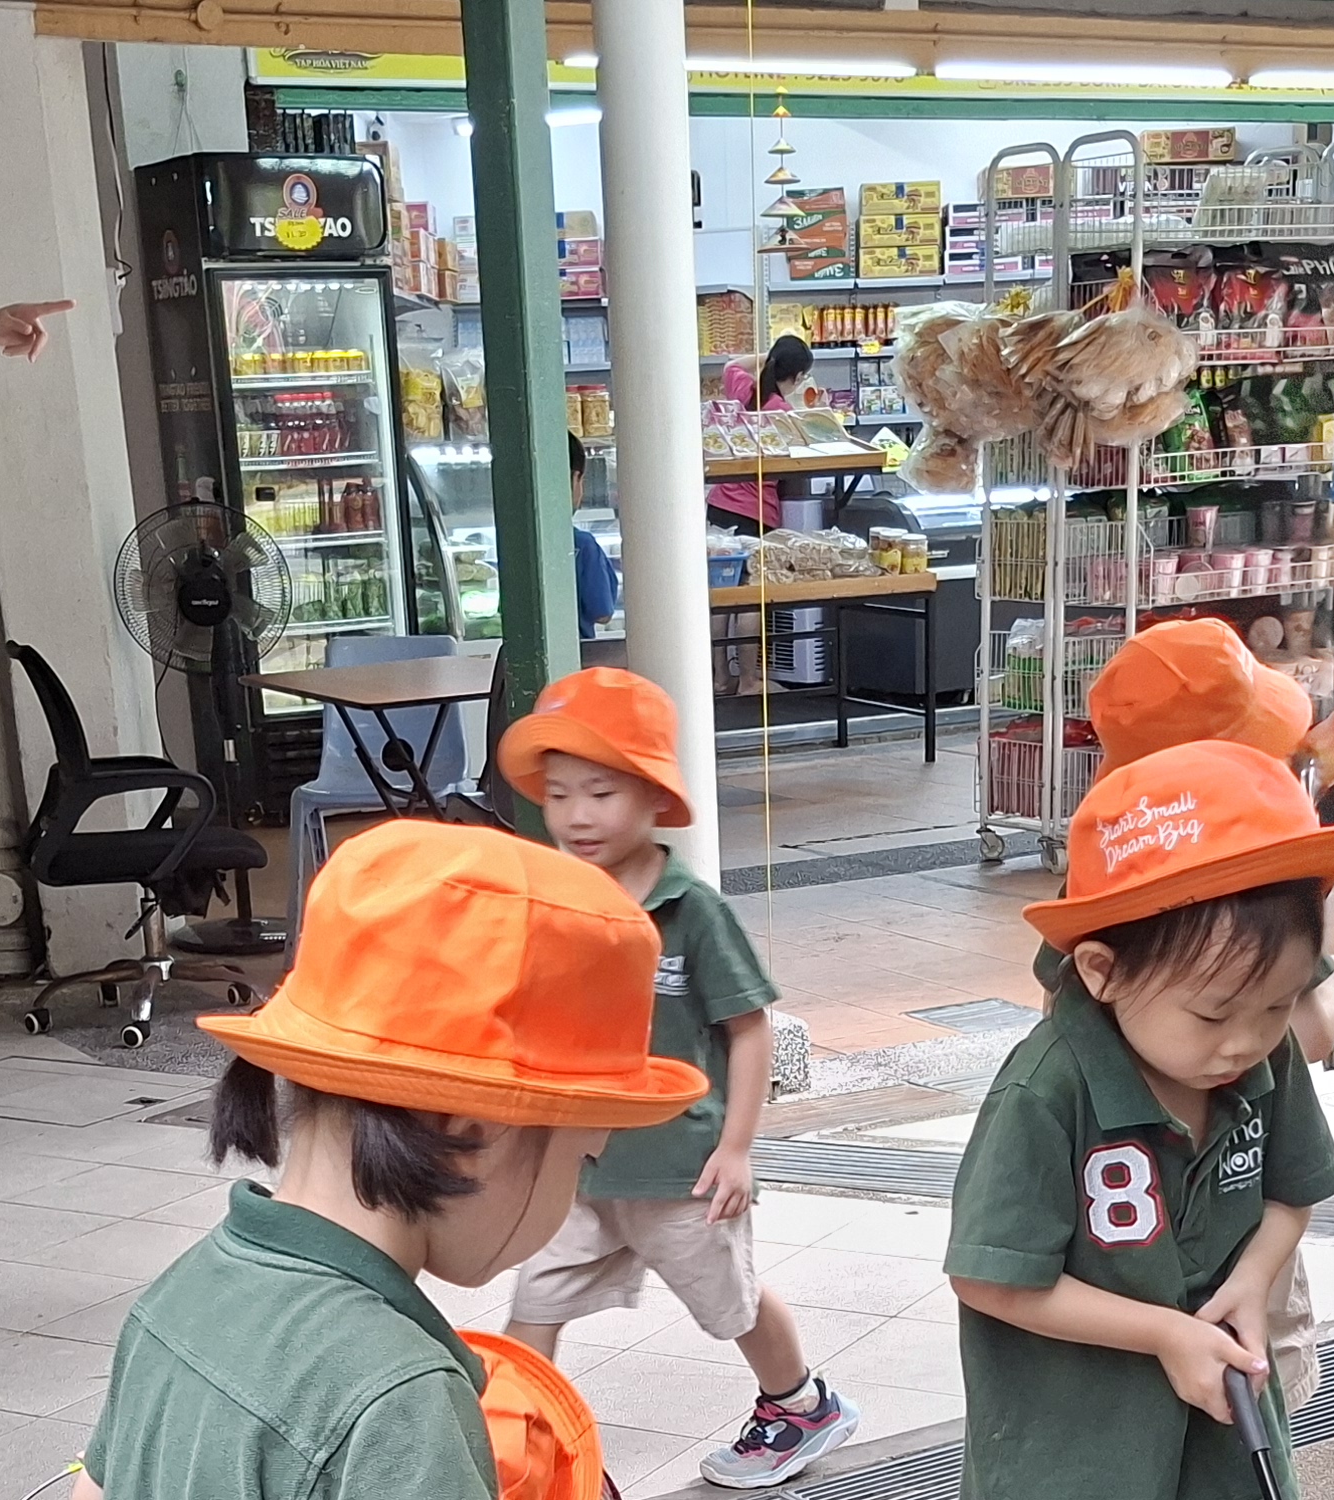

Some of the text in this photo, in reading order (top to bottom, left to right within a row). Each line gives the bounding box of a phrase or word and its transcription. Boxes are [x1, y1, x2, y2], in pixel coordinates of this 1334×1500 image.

[278, 207, 308, 218] SALE
[1096, 790, 1199, 849] Start Small
[1102, 816, 1206, 875] Dream Big
[1082, 1142, 1162, 1247] 8
